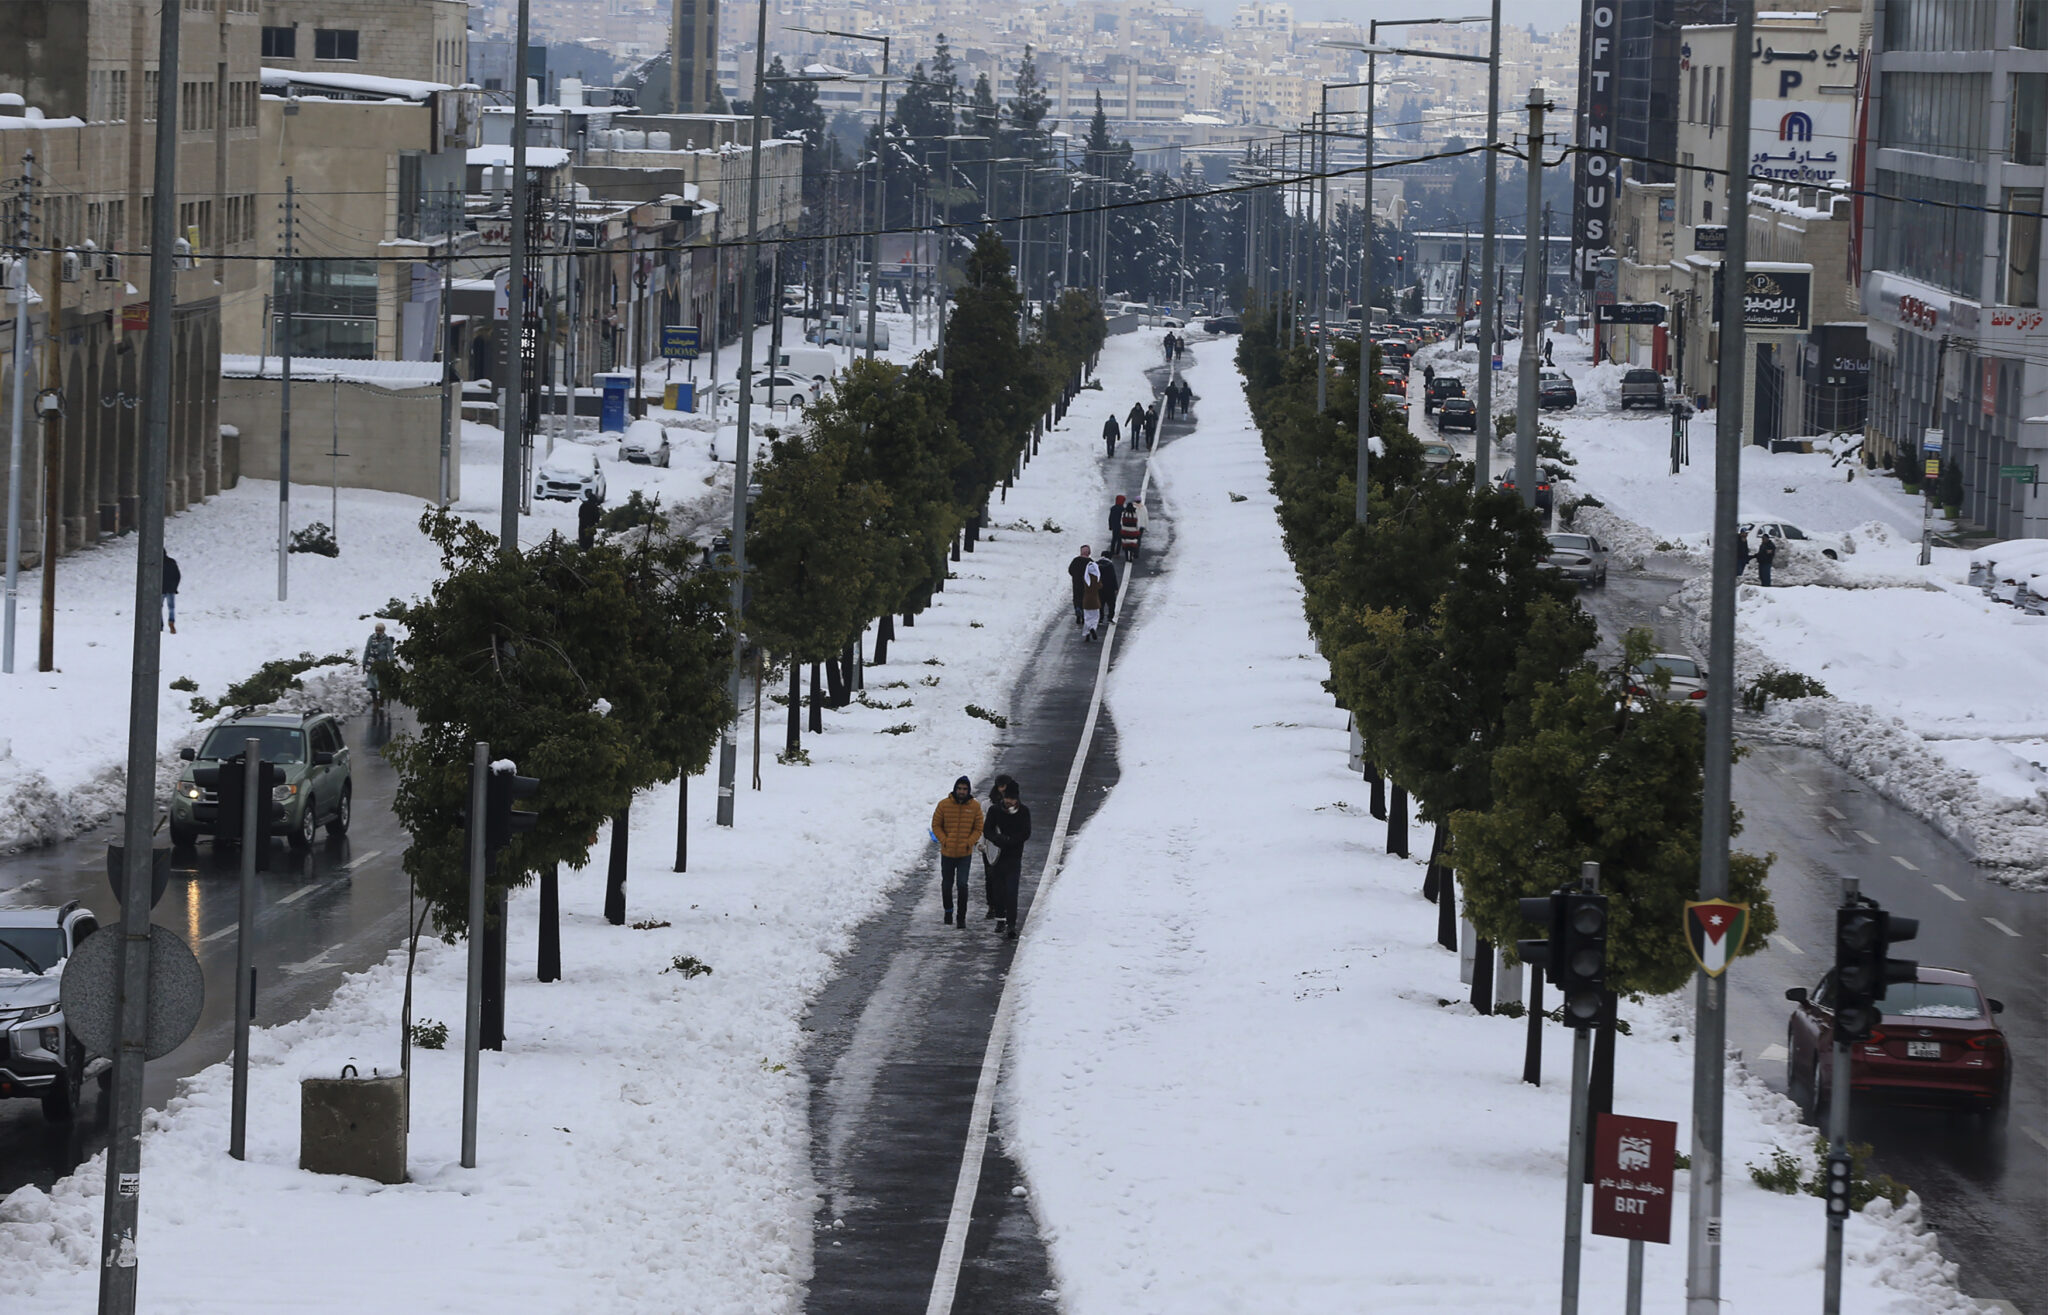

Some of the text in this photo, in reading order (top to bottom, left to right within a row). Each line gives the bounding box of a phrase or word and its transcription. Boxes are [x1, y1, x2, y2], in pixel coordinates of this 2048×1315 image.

[1752, 36, 1818, 64] مول
[1779, 70, 1802, 98] P
[1752, 147, 1837, 163] كارفور
[1751, 164, 1837, 180] Carrefour
[1584, 126, 1608, 271] HOUSE
[1757, 277, 1765, 288] P
[1744, 296, 1796, 313] بريميو
[1991, 311, 2042, 330] خزائن حائط
[664, 347, 698, 356] ROOMS
[1600, 1177, 1664, 1195] موقف نقل عام
[1615, 1196, 1648, 1215] BRT
